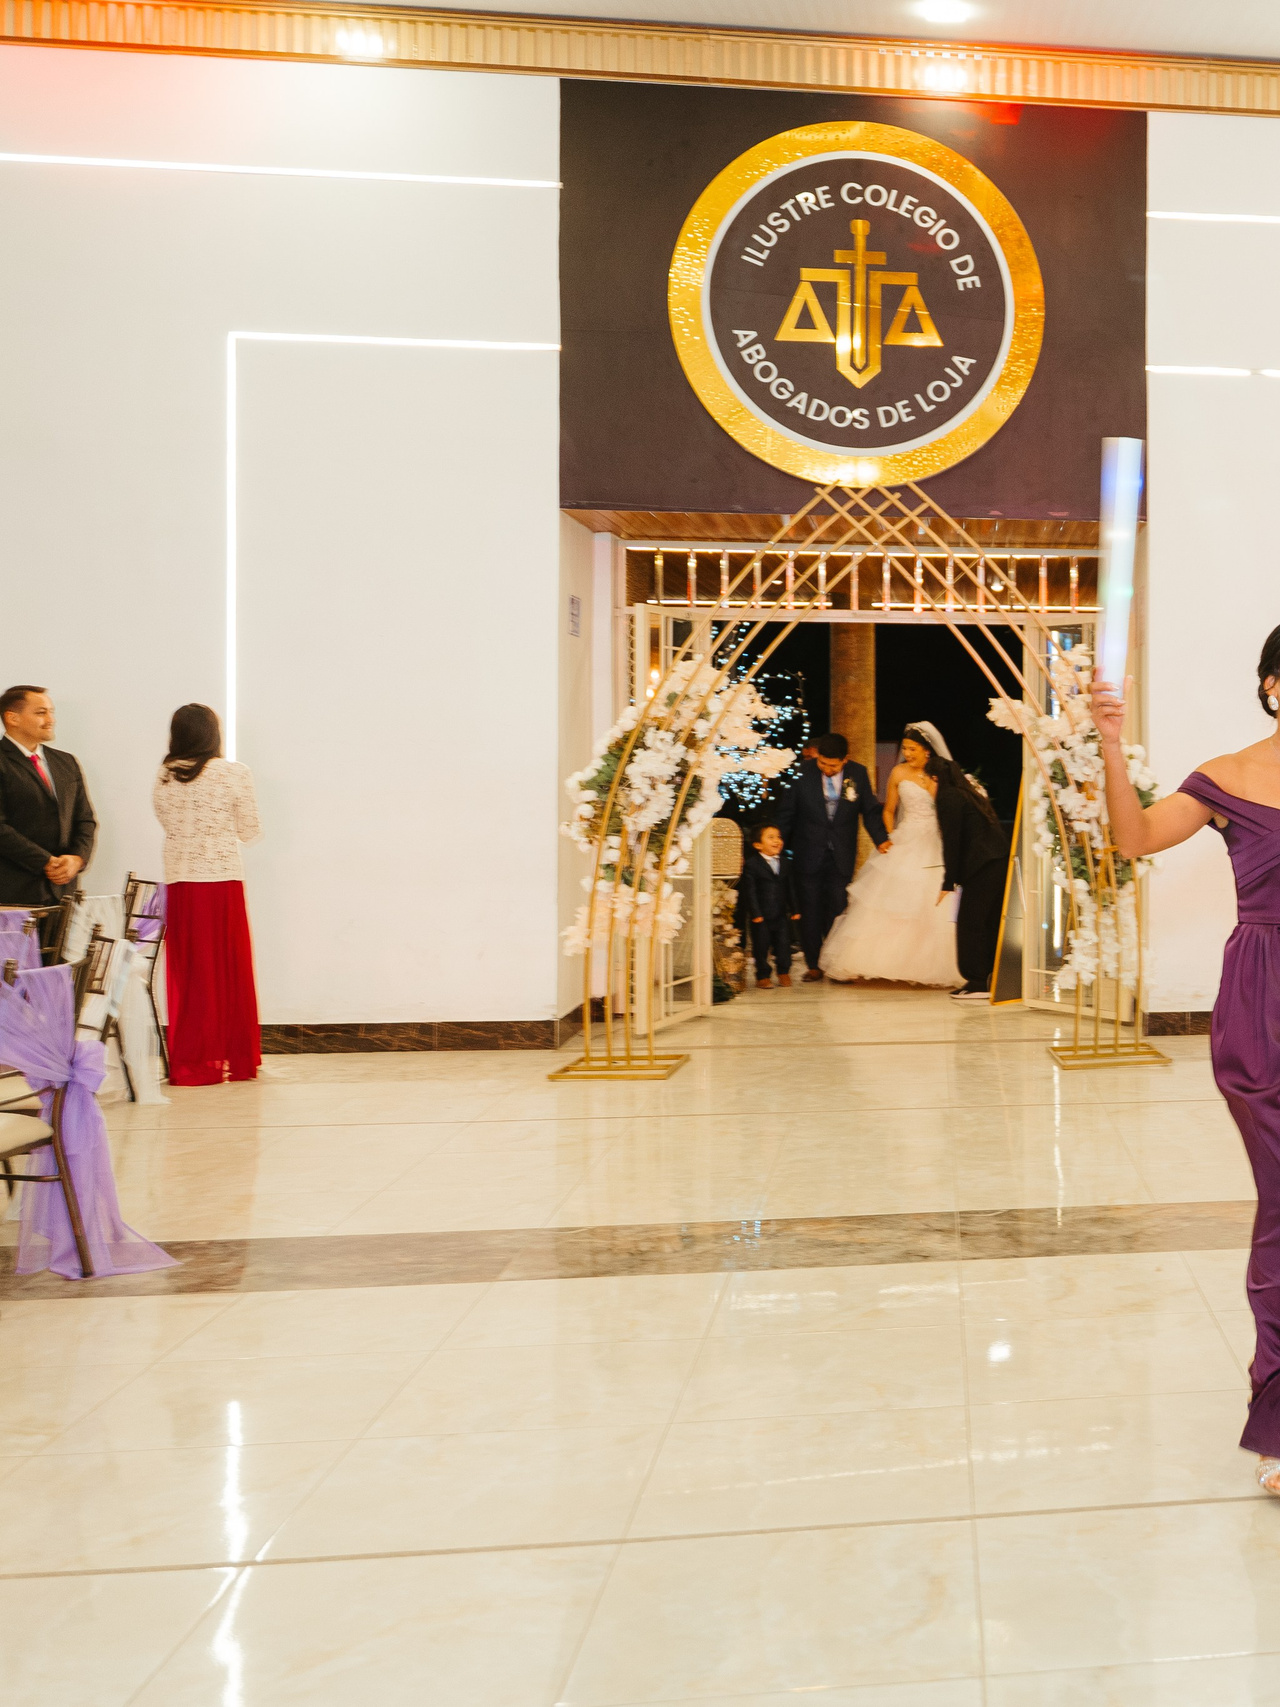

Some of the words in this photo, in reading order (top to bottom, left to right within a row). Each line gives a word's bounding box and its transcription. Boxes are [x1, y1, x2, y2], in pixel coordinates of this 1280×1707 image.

[740, 185, 835, 267] ILUSTRE
[840, 182, 960, 251] COLEGIO
[949, 253, 982, 291] DE
[731, 328, 870, 430] ABOGADOS
[875, 399, 916, 429] DE
[913, 354, 977, 413] LOJA
